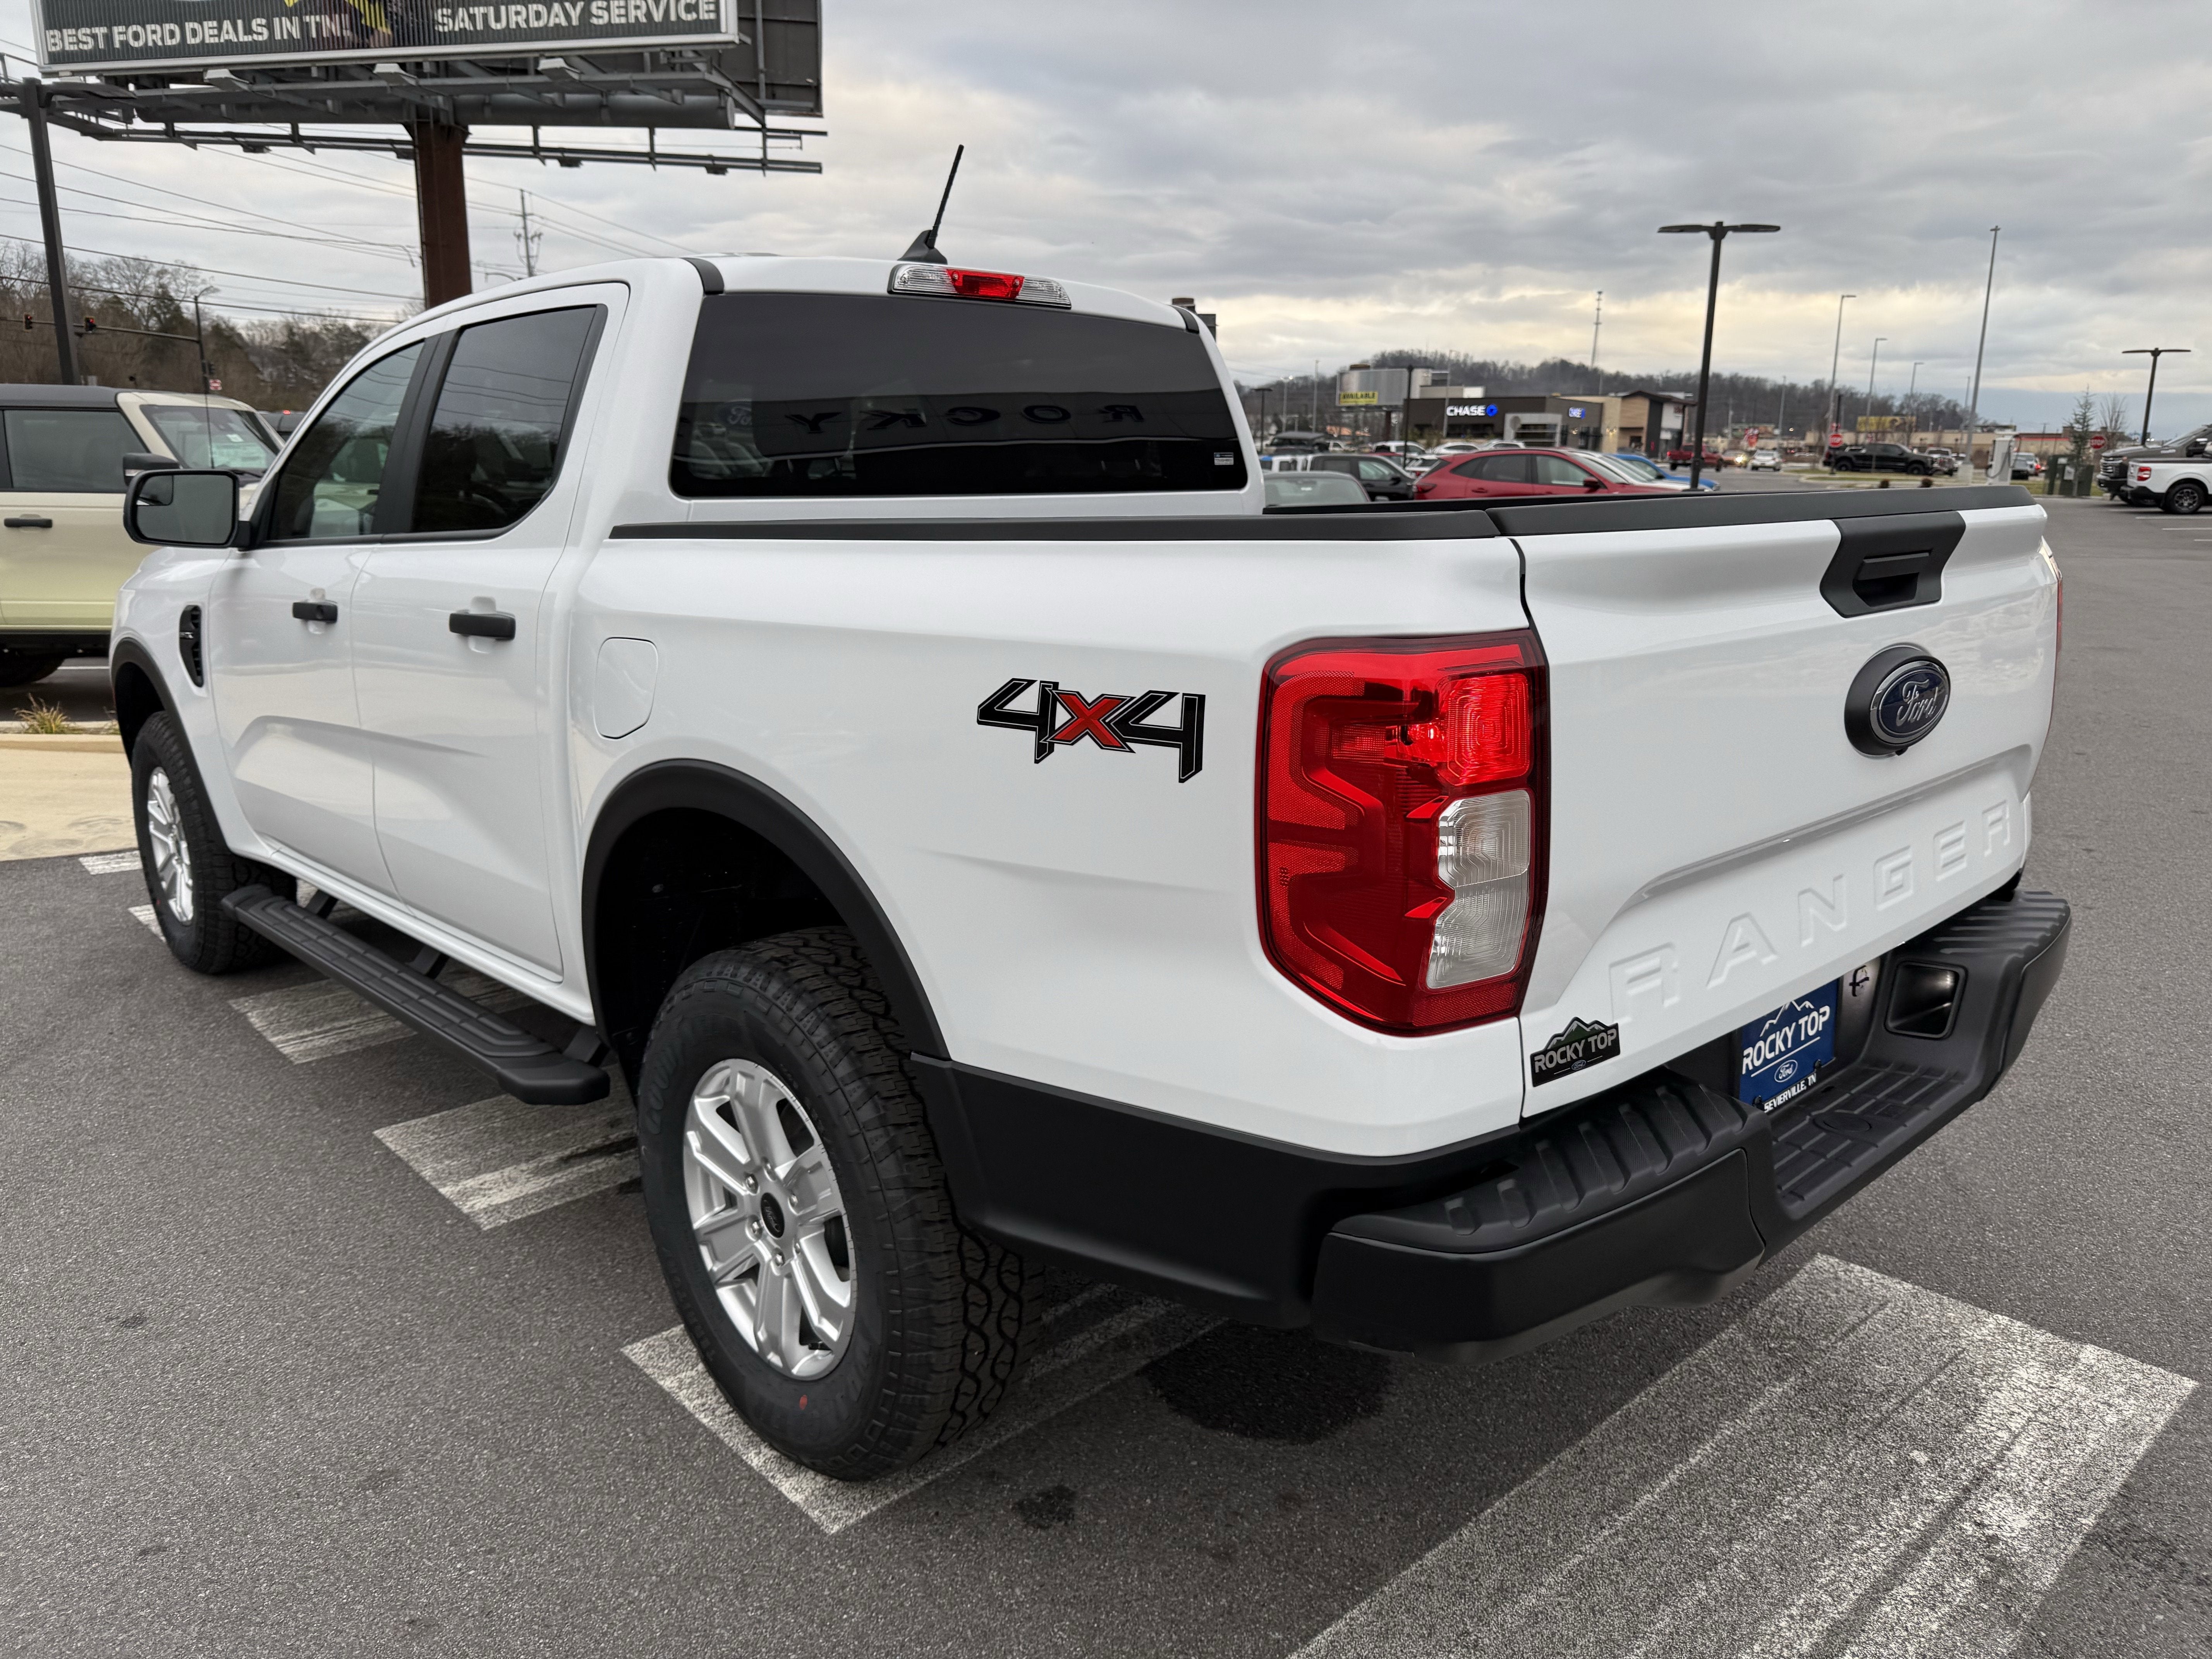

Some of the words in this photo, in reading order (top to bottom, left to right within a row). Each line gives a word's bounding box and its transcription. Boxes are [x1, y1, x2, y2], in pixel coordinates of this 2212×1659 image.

[45, 27, 107, 52] BEST
[112, 23, 180, 48] FORD
[185, 18, 269, 44] DEALS
[273, 16, 300, 40] IN
[434, 2, 583, 32] SATURDAY
[590, 0, 717, 25] SERVICE
[1446, 405, 1486, 416] CHASE
[1896, 679, 1939, 726] Ford
[1609, 800, 2010, 1024] RANGER
[1534, 1039, 1585, 1073] ROCKY
[1588, 1028, 1617, 1053] TOP
[1742, 1022, 1796, 1075] ROCKY
[1799, 1005, 1830, 1041] TOP
[1779, 1063, 1793, 1079] Ford
[1808, 1073, 1817, 1086] TN
